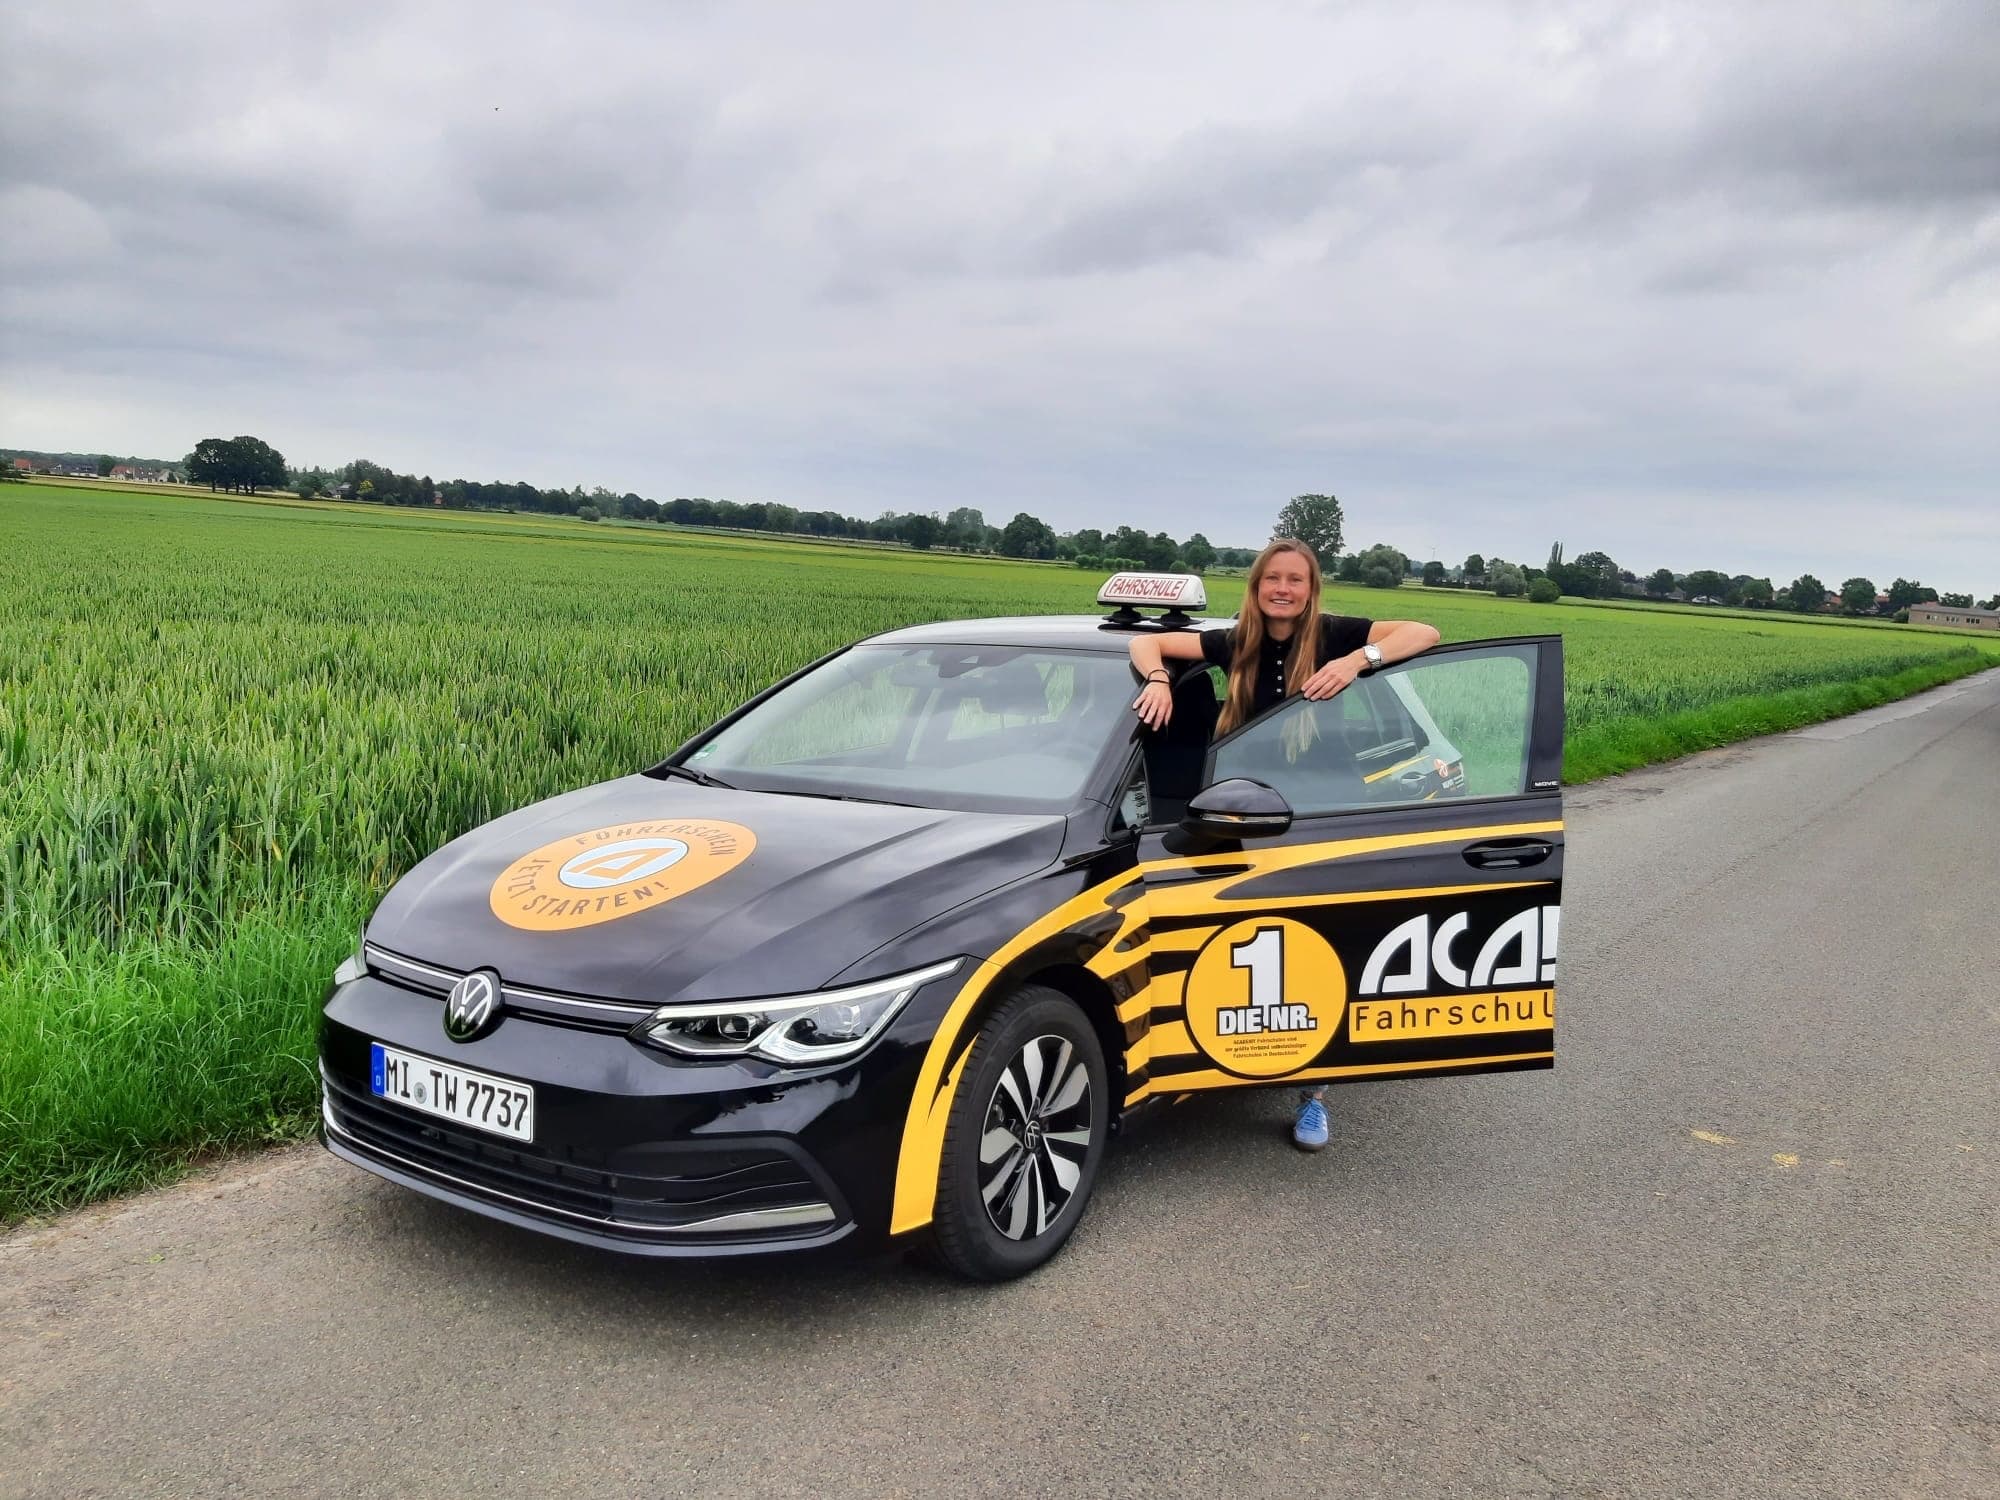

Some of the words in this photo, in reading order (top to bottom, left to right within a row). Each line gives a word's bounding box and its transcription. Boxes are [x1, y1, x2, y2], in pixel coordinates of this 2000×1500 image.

[1108, 578, 1184, 597] FAHRSCHULE
[507, 858, 552, 900] JETZT
[522, 880, 670, 917] STARTEN!
[1231, 927, 1284, 1012] 1
[1217, 1008, 1264, 1036] DIE
[1269, 1005, 1317, 1033] NR.
[375, 1075, 381, 1086] D
[385, 1055, 411, 1099] MI
[430, 1069, 458, 1114] TW
[466, 1079, 529, 1132] 7737
